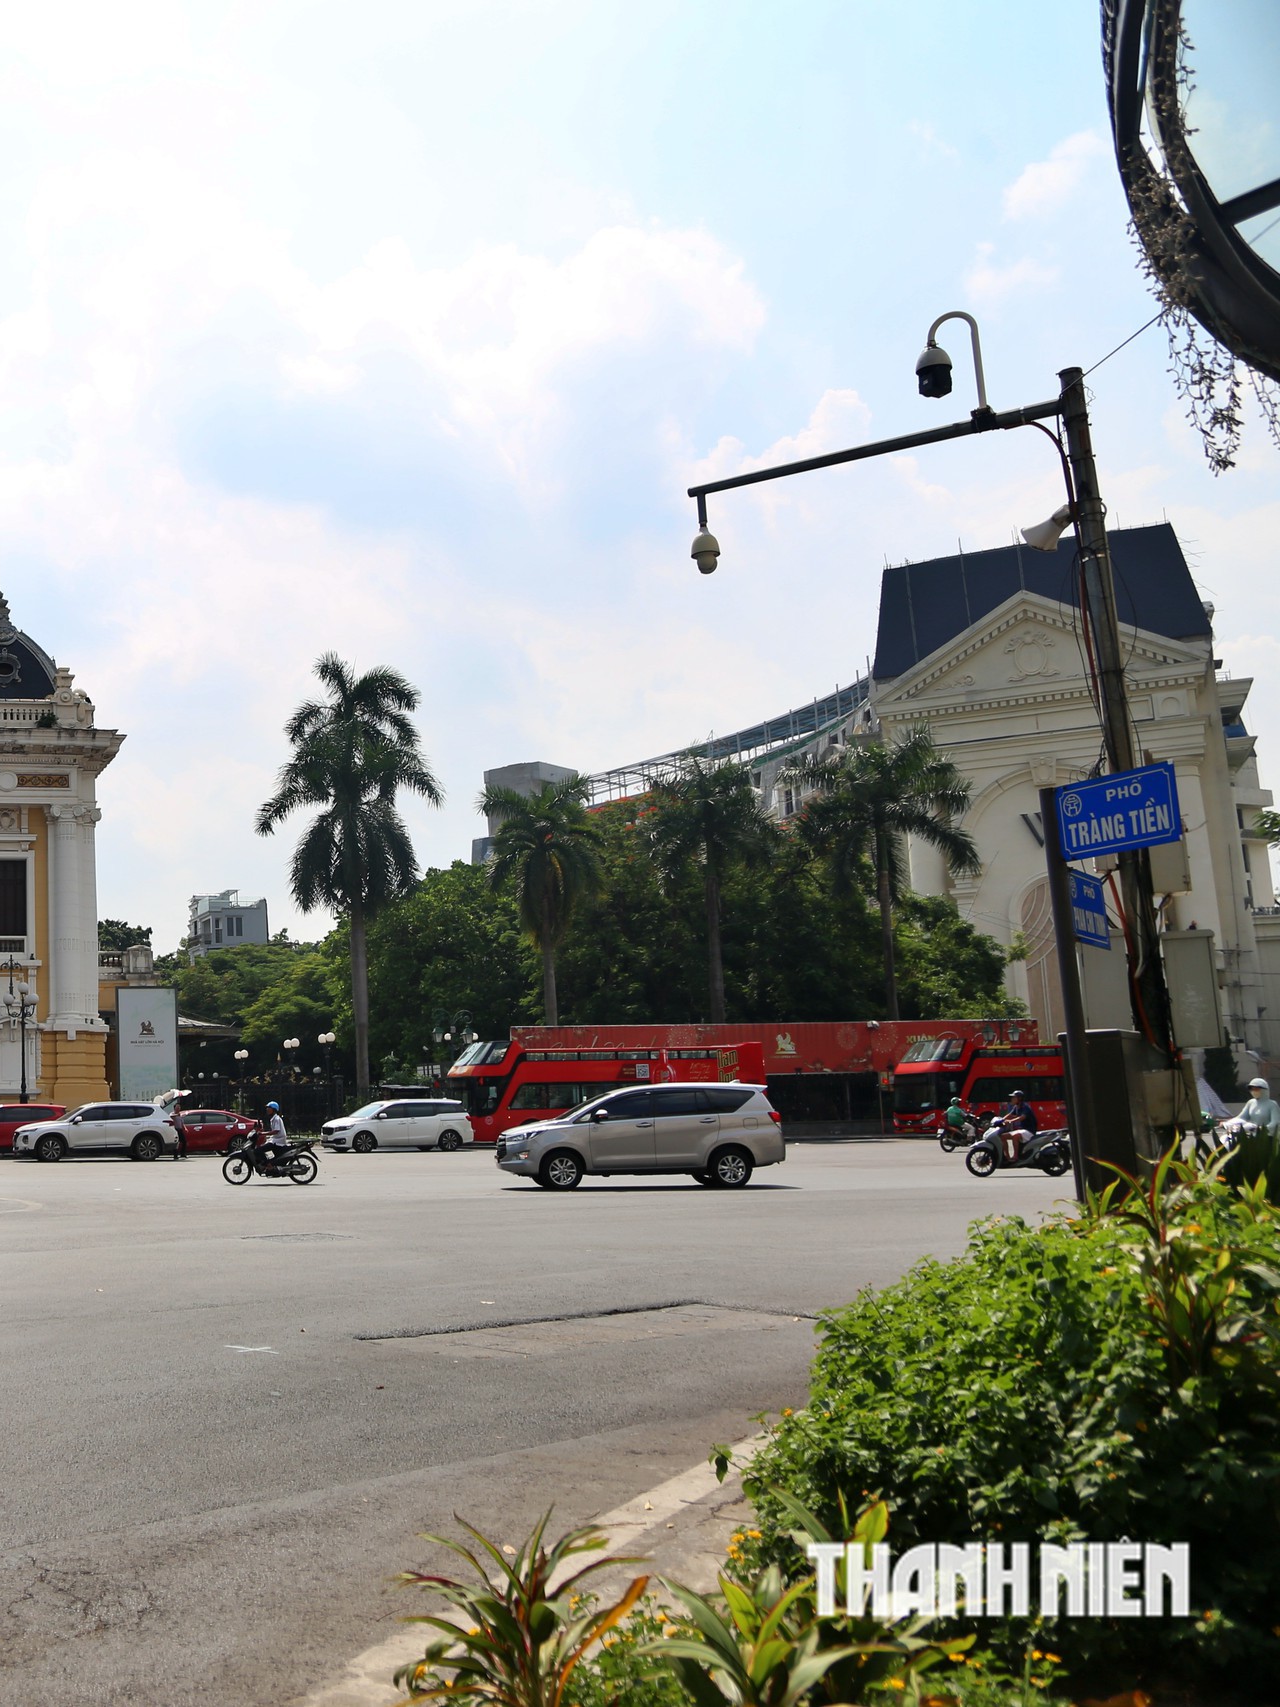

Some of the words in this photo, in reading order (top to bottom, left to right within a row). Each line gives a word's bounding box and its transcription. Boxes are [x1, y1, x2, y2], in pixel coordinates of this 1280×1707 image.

[1105, 777, 1142, 802] PHỐ
[1068, 812, 1126, 848] TRÀNG
[1128, 797, 1170, 836] TIỀN
